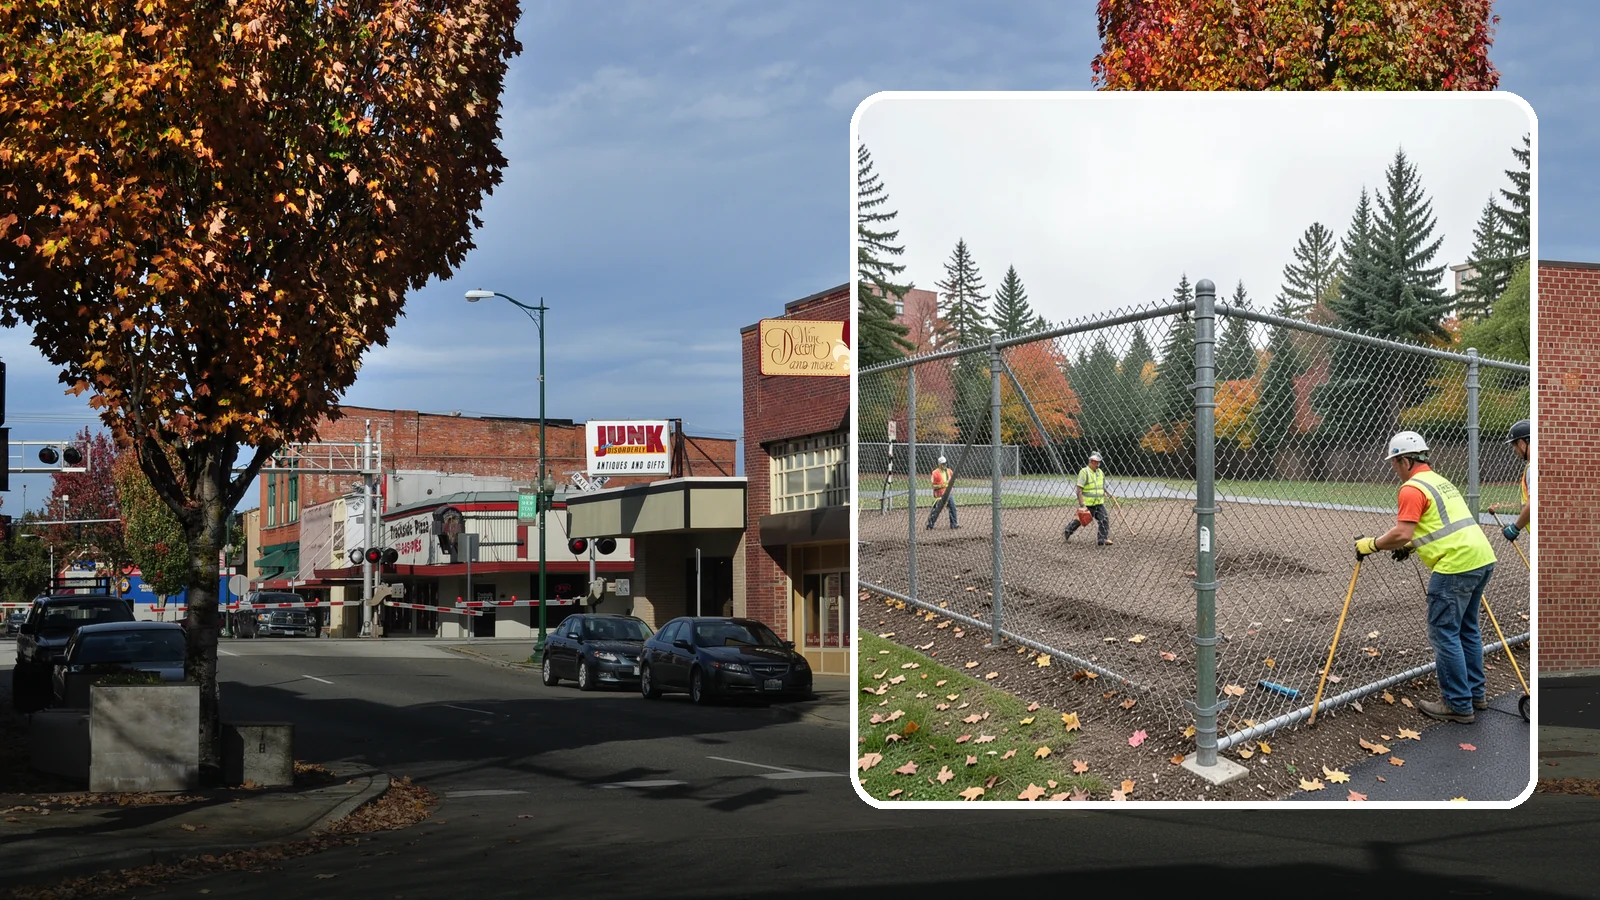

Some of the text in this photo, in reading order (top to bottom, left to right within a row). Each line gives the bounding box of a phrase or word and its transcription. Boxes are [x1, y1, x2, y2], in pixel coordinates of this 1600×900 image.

[595, 425, 665, 457] JUNK
[607, 446, 646, 454] DISORDERLY
[597, 460, 665, 470] ANTIQUES AND GIFTS
[390, 520, 429, 540] Trackside Pizza
